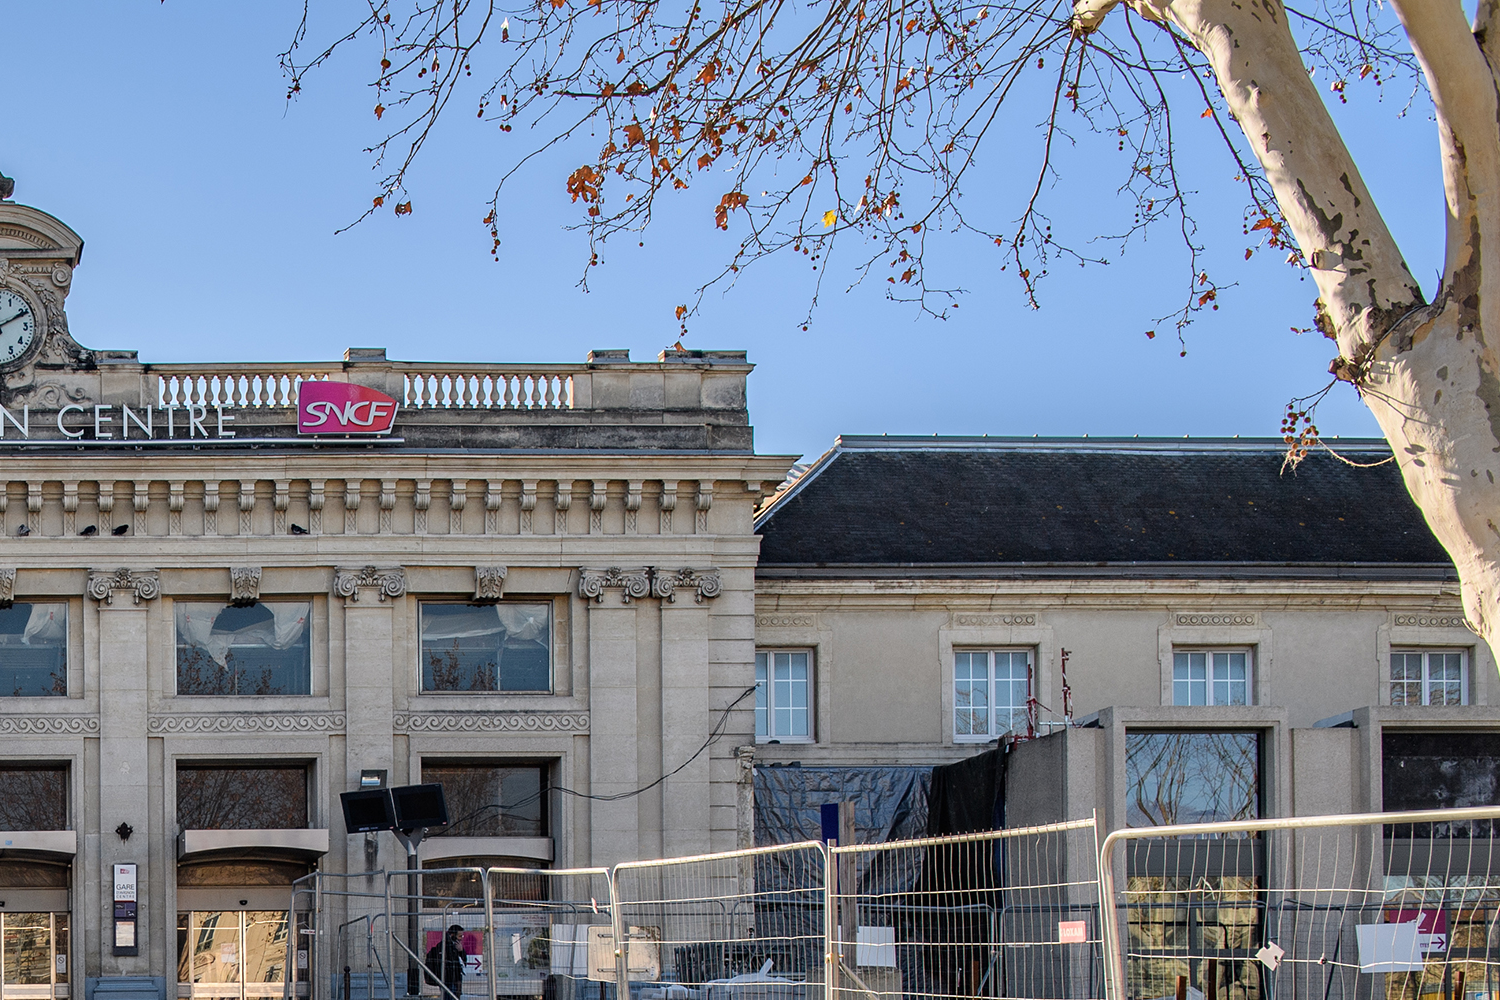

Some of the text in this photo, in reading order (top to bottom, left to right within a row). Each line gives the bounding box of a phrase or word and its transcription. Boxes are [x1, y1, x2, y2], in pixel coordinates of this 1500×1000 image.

[8, 298, 12, 307] 1
[23, 322, 29, 331] 3
[17, 336, 24, 345] 4
[8, 345, 14, 355] 5
[302, 401, 393, 426] SNCF
[57, 404, 236, 438] CENTRE
